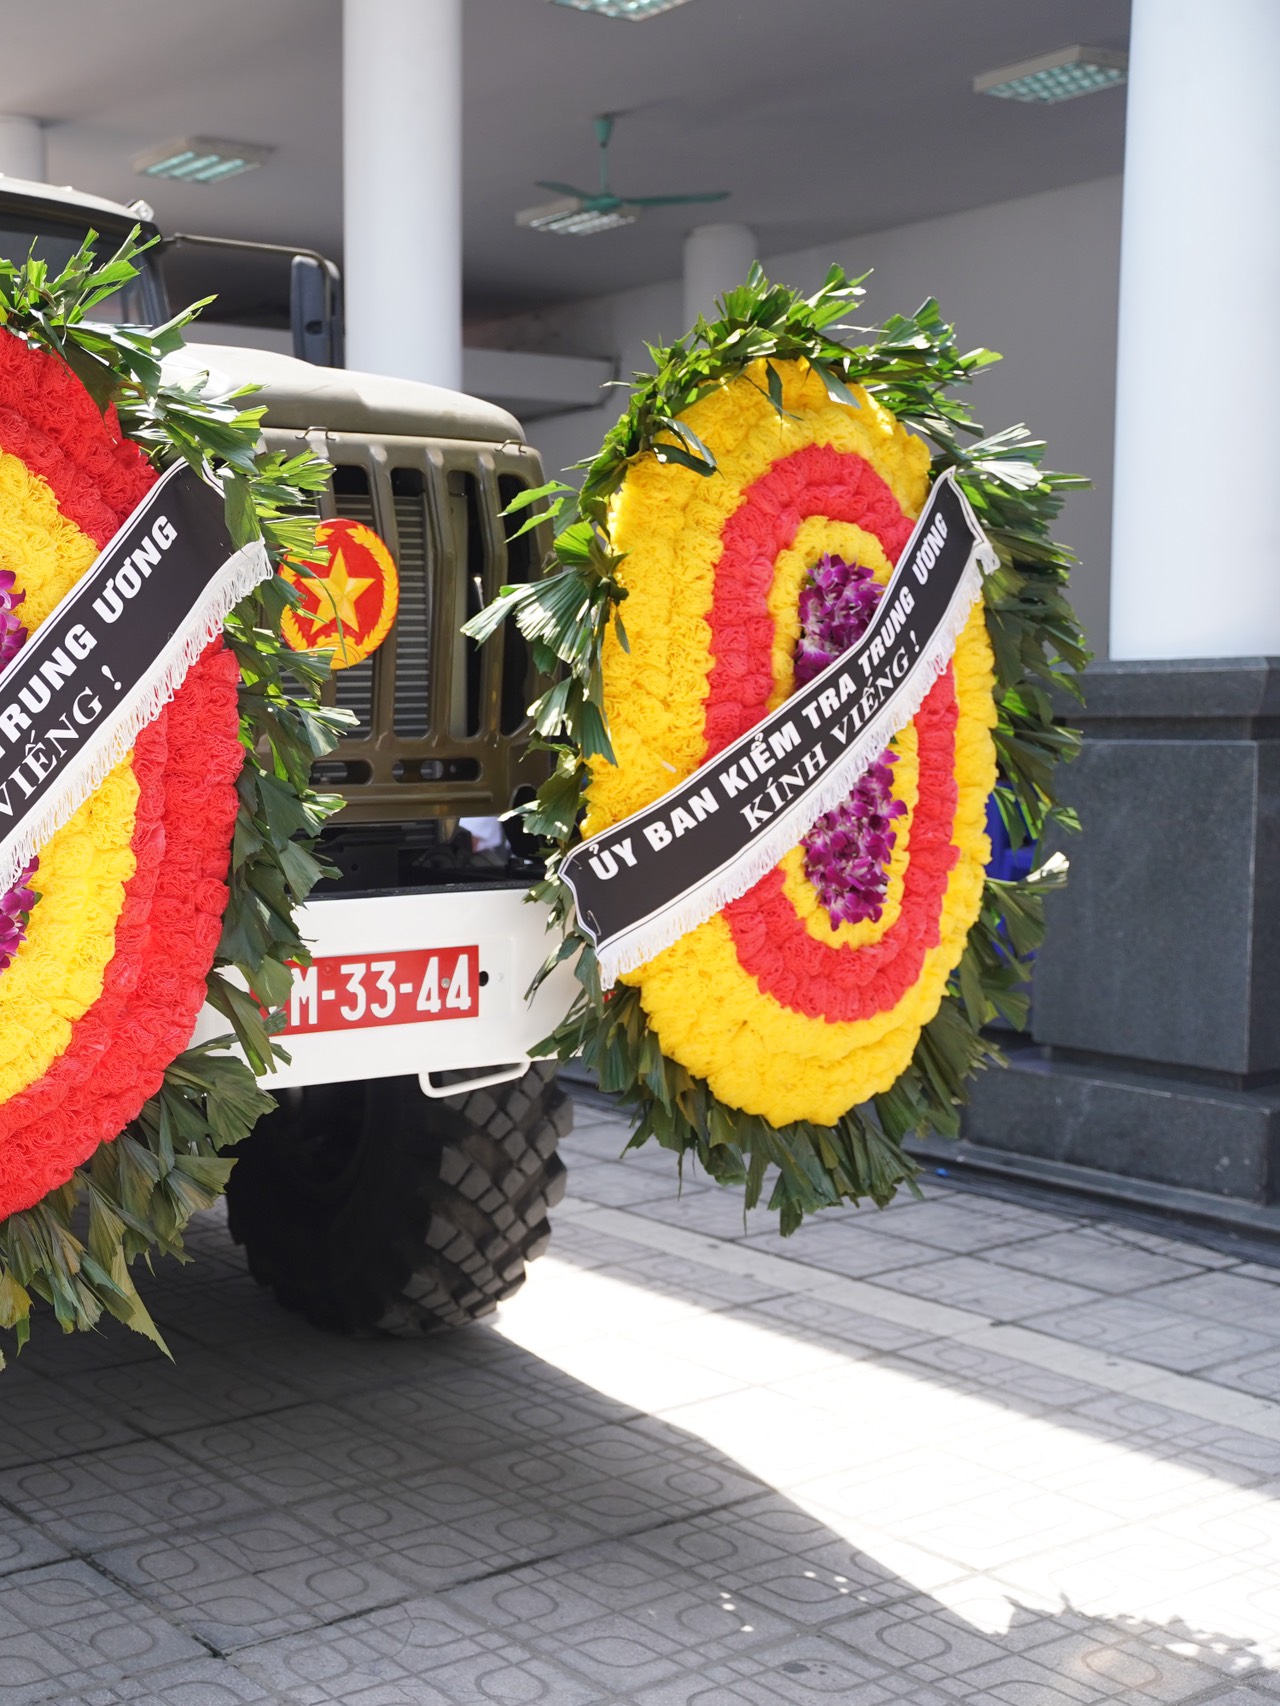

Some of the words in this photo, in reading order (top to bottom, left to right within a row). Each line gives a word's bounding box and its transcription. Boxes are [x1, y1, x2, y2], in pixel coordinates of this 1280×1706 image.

[93, 515, 177, 624] ƯƠNG
[101, 664, 123, 691] !
[588, 842, 637, 880] ỦY
[643, 787, 719, 852] BAN
[719, 733, 801, 799] KIỂM
[802, 673, 856, 728] TRA
[858, 586, 914, 676] TRUNG
[912, 512, 948, 584] ƯƠNG
[740, 742, 827, 832] KÍNH
[831, 647, 908, 744] VIẾNG
[909, 630, 921, 653] !
[266, 954, 471, 1026] M-33-44
